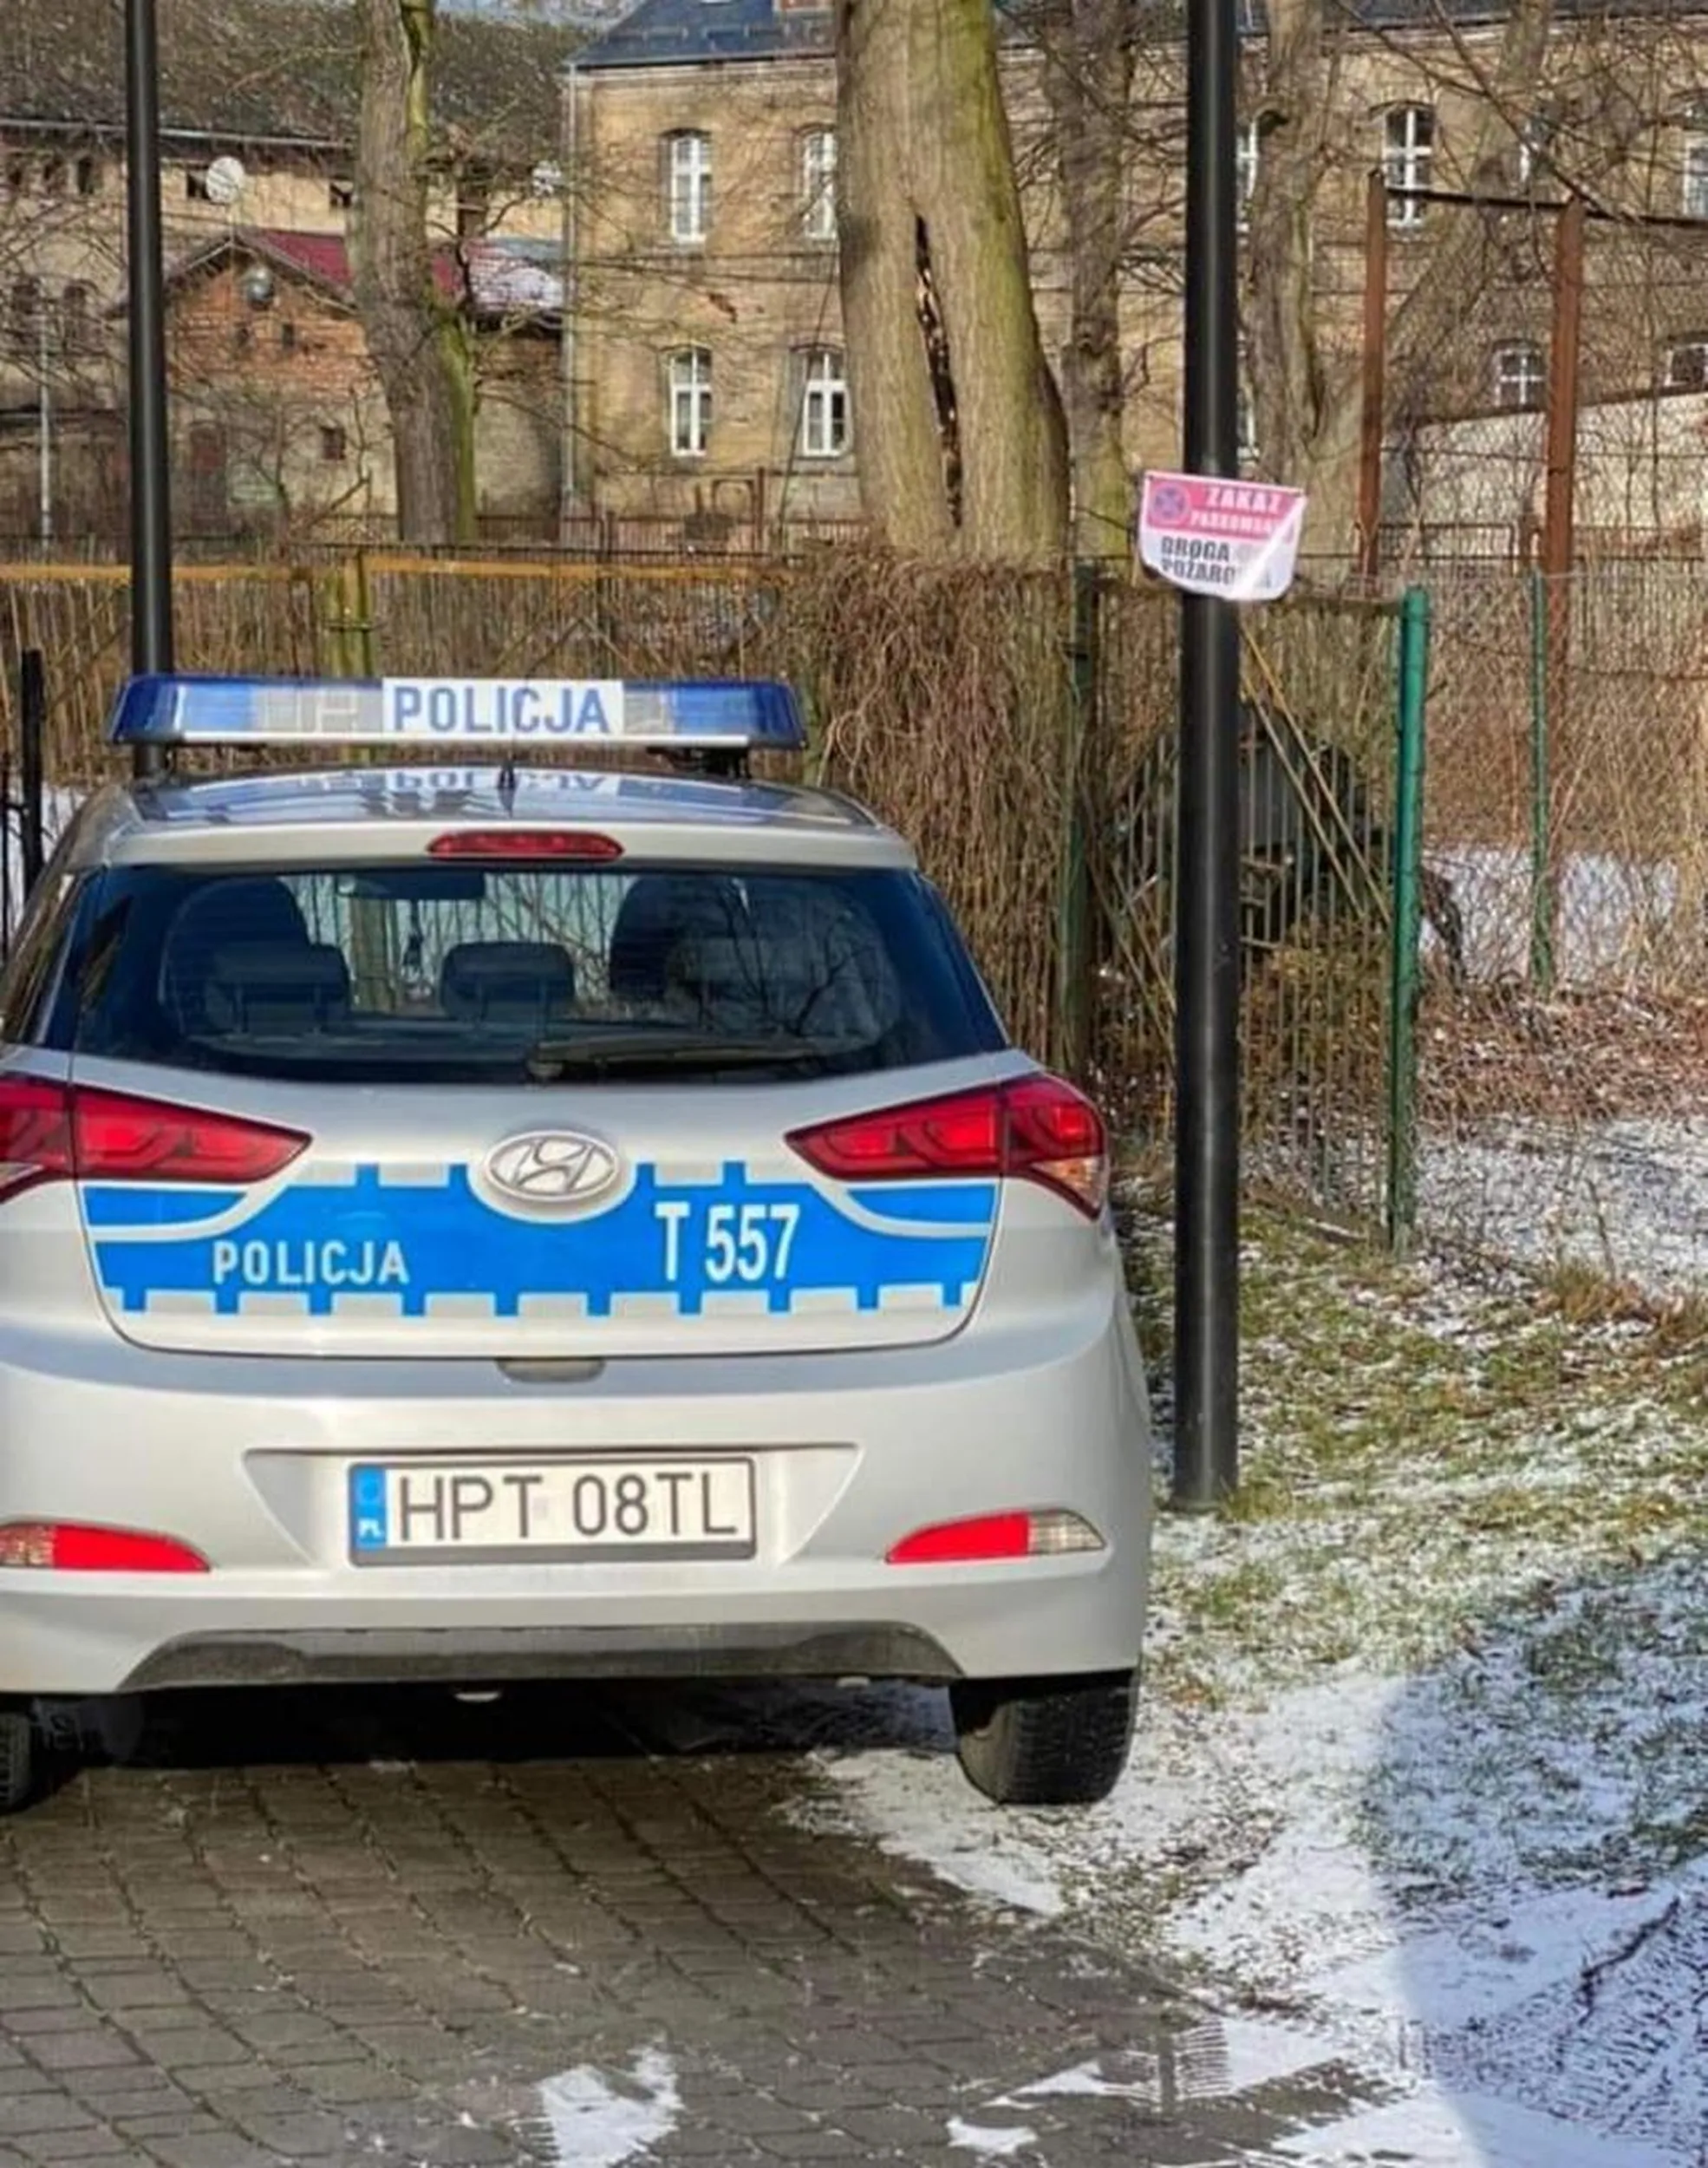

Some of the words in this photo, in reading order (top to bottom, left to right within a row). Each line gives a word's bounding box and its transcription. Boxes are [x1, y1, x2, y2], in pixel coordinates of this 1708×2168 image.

[1206, 486, 1282, 514] ZAKAZ
[1162, 536, 1230, 562] DROGA
[394, 687, 609, 733] POLICJA
[212, 1240, 409, 1284] POLICJA
[655, 1201, 690, 1281] T
[705, 1203, 801, 1282] 557
[401, 1476, 543, 1541] HPT
[573, 1472, 737, 1537] 08TL
